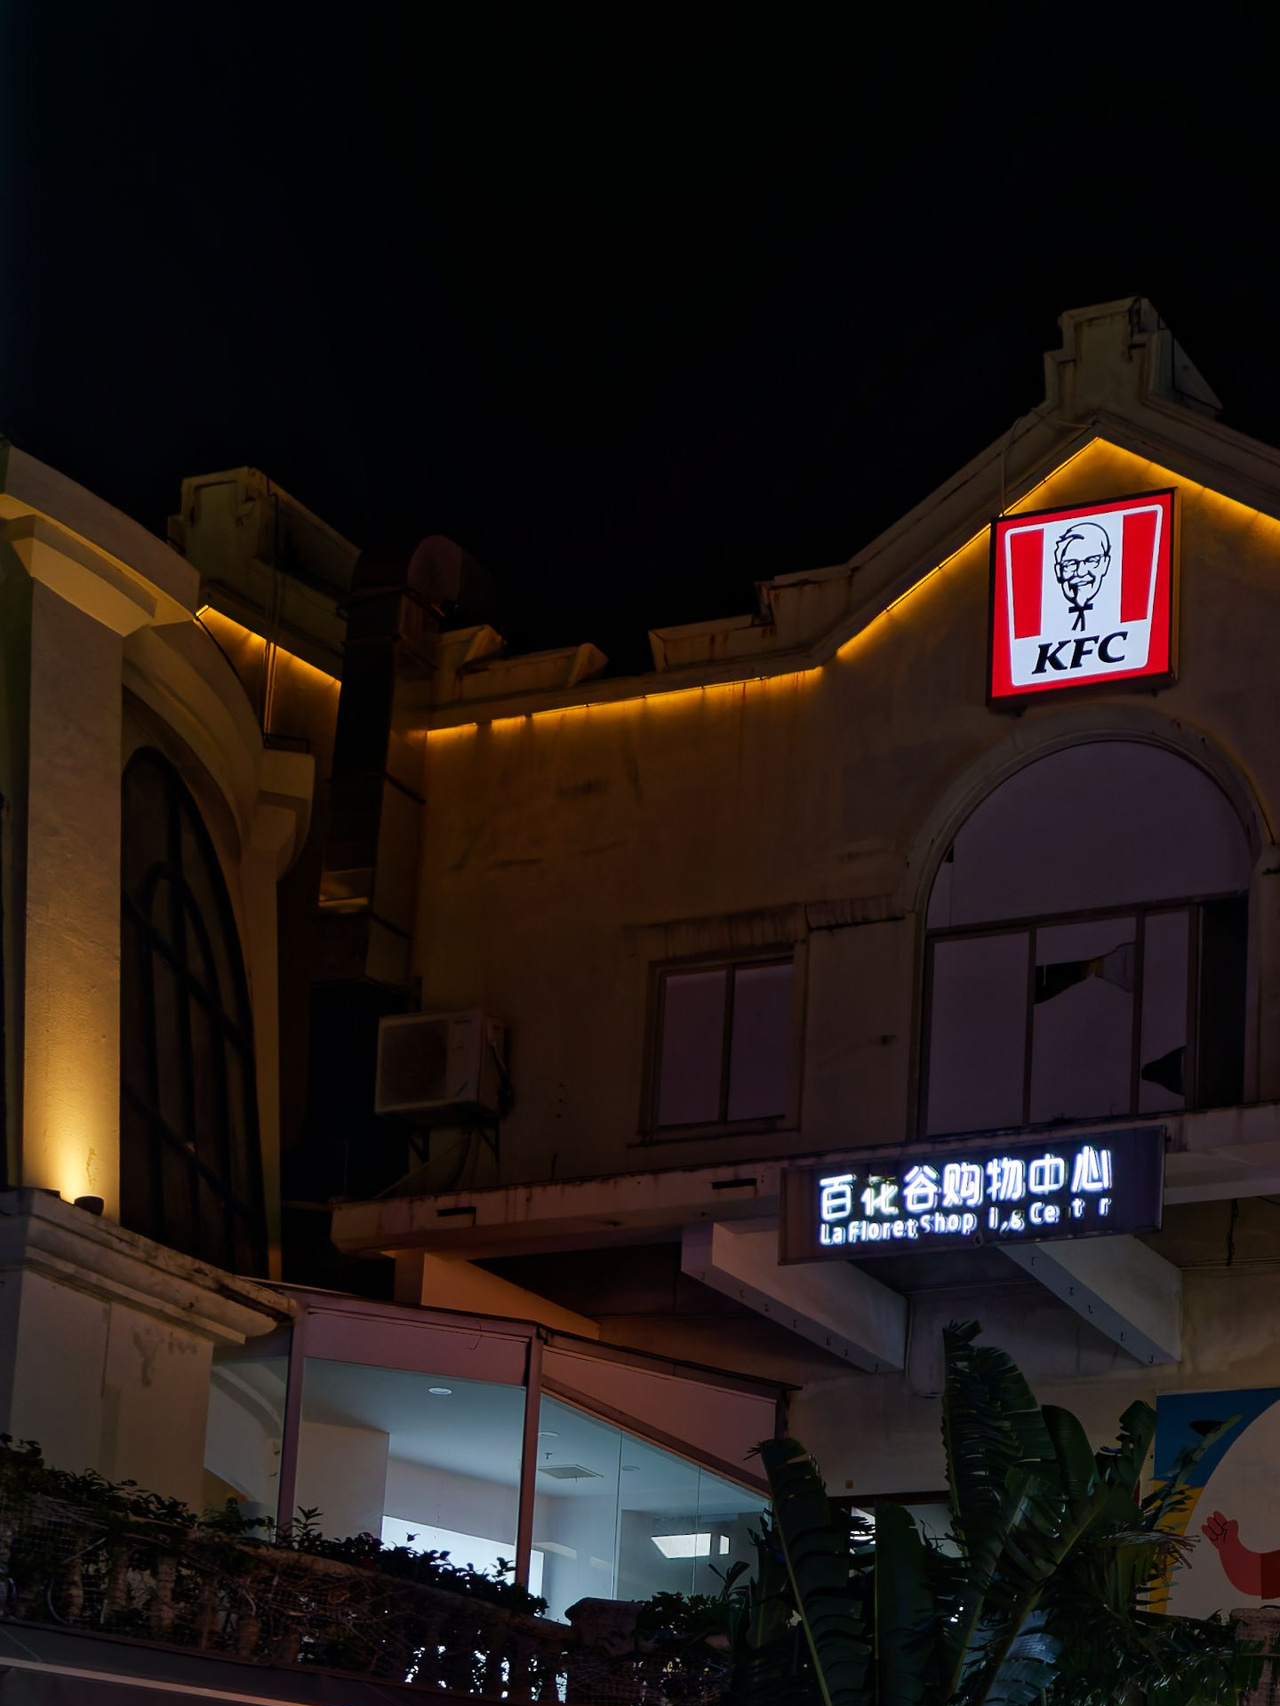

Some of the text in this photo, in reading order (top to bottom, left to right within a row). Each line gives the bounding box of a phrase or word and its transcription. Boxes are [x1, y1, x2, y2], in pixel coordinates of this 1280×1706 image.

[1031, 631, 1128, 675] KFC
[820, 1146, 1112, 1221] 百花谷购物中心
[821, 1223, 845, 1244] La
[848, 1215, 919, 1243] Floret
